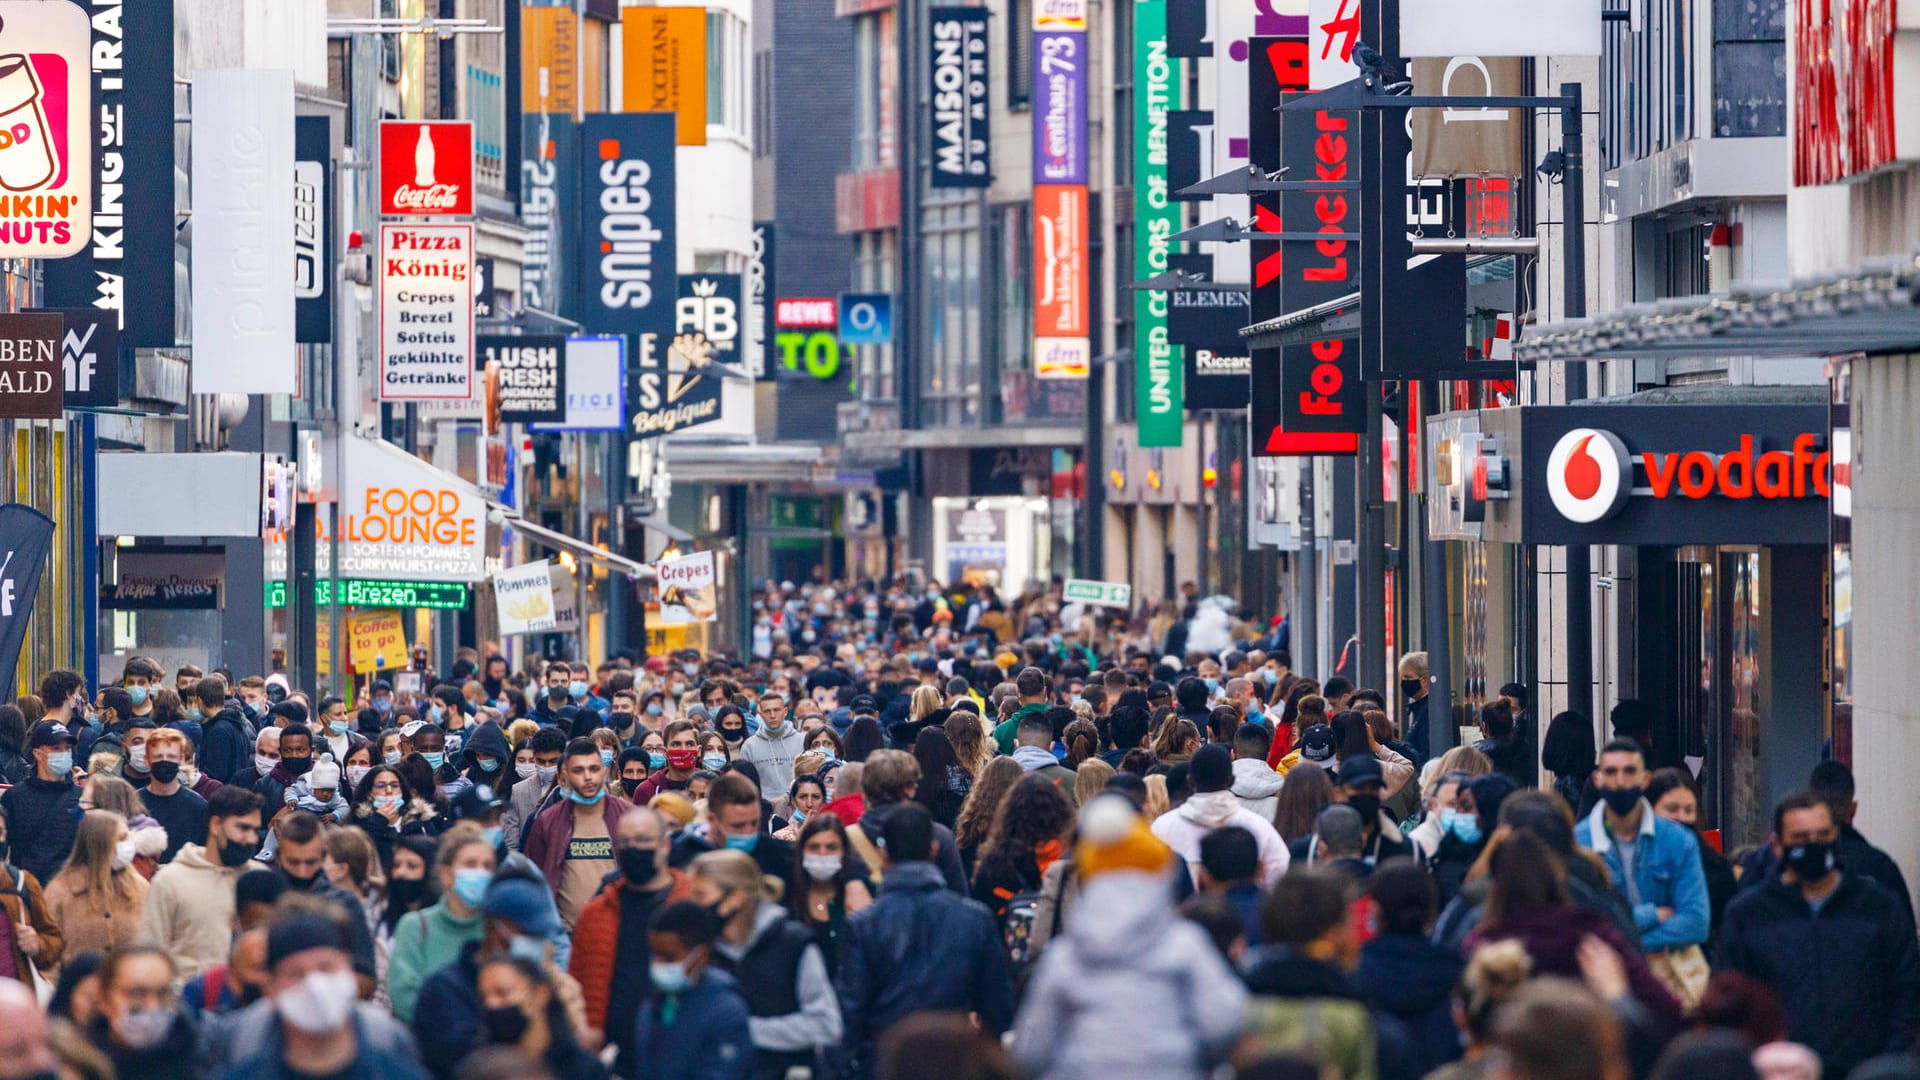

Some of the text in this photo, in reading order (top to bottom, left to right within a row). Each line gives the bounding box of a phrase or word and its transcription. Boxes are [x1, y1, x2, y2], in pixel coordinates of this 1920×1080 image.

[92, 0, 123, 91] TRA
[1040, 36, 1075, 75] 73
[934, 21, 963, 174] MAISONS
[969, 21, 986, 175] DU MONDE
[1147, 175, 1169, 208] OF
[391, 231, 462, 250] Pizza
[600, 159, 662, 309] snipes
[387, 259, 466, 281] König
[397, 291, 455, 306] Crepes
[400, 312, 453, 323] Brezel
[397, 332, 456, 344] Softeis
[0, 339, 56, 362] BEN
[389, 352, 464, 366] gekühlte
[776, 333, 839, 379] TO
[1046, 344, 1080, 362] dm
[1149, 327, 1171, 413] UNITED
[1300, 312, 1344, 416] Foo
[386, 370, 467, 384] Getränke
[500, 368, 557, 386] RESH
[632, 399, 717, 434] Belgique
[366, 488, 460, 517] FOOD
[350, 513, 476, 545] LOUNGE
[661, 563, 710, 581] Crepes
[348, 582, 417, 602] Brezen
[496, 573, 548, 593] Pommes
[353, 619, 398, 636] Coffee
[357, 634, 396, 650] to go
[570, 841, 612, 850] GLORIOUS
[571, 849, 610, 857] GANGSTA
